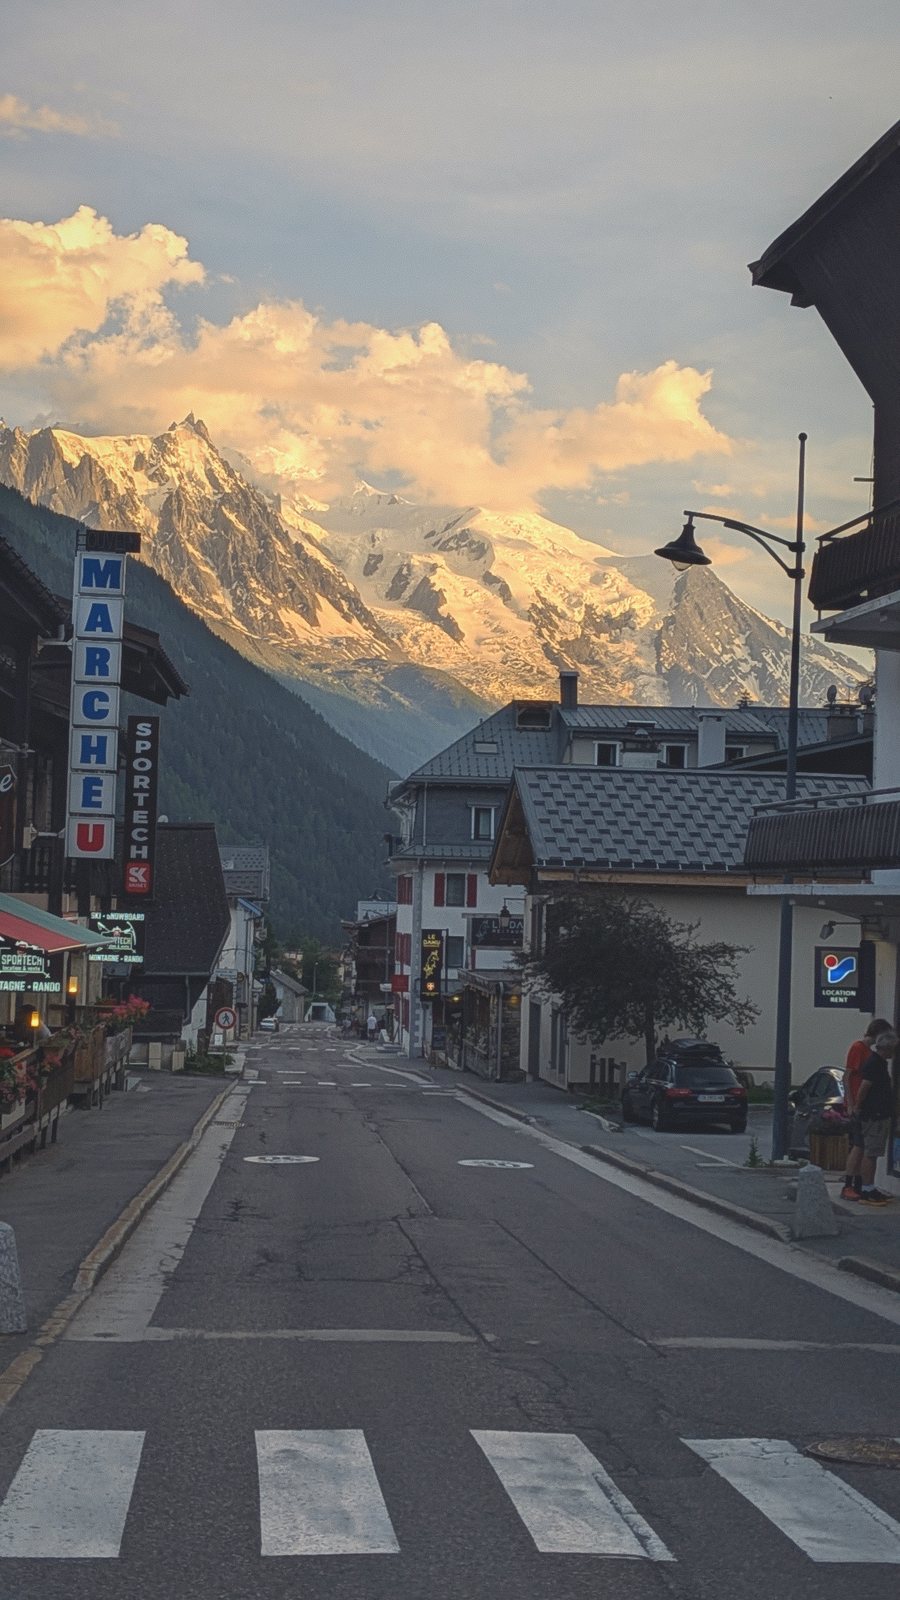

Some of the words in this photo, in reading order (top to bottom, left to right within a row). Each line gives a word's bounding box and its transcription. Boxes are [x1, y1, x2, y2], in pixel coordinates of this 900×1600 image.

[80, 558, 122, 808] MARCHE
[130, 723, 152, 859] SPORTECH
[76, 823, 105, 852] U
[106, 912, 145, 921] SNOWBOARD
[1, 955, 42, 966] SPORTECH
[89, 954, 119, 962] MONTAGNE
[124, 955, 143, 963] RANDO
[33, 982, 60, 992] RANDO
